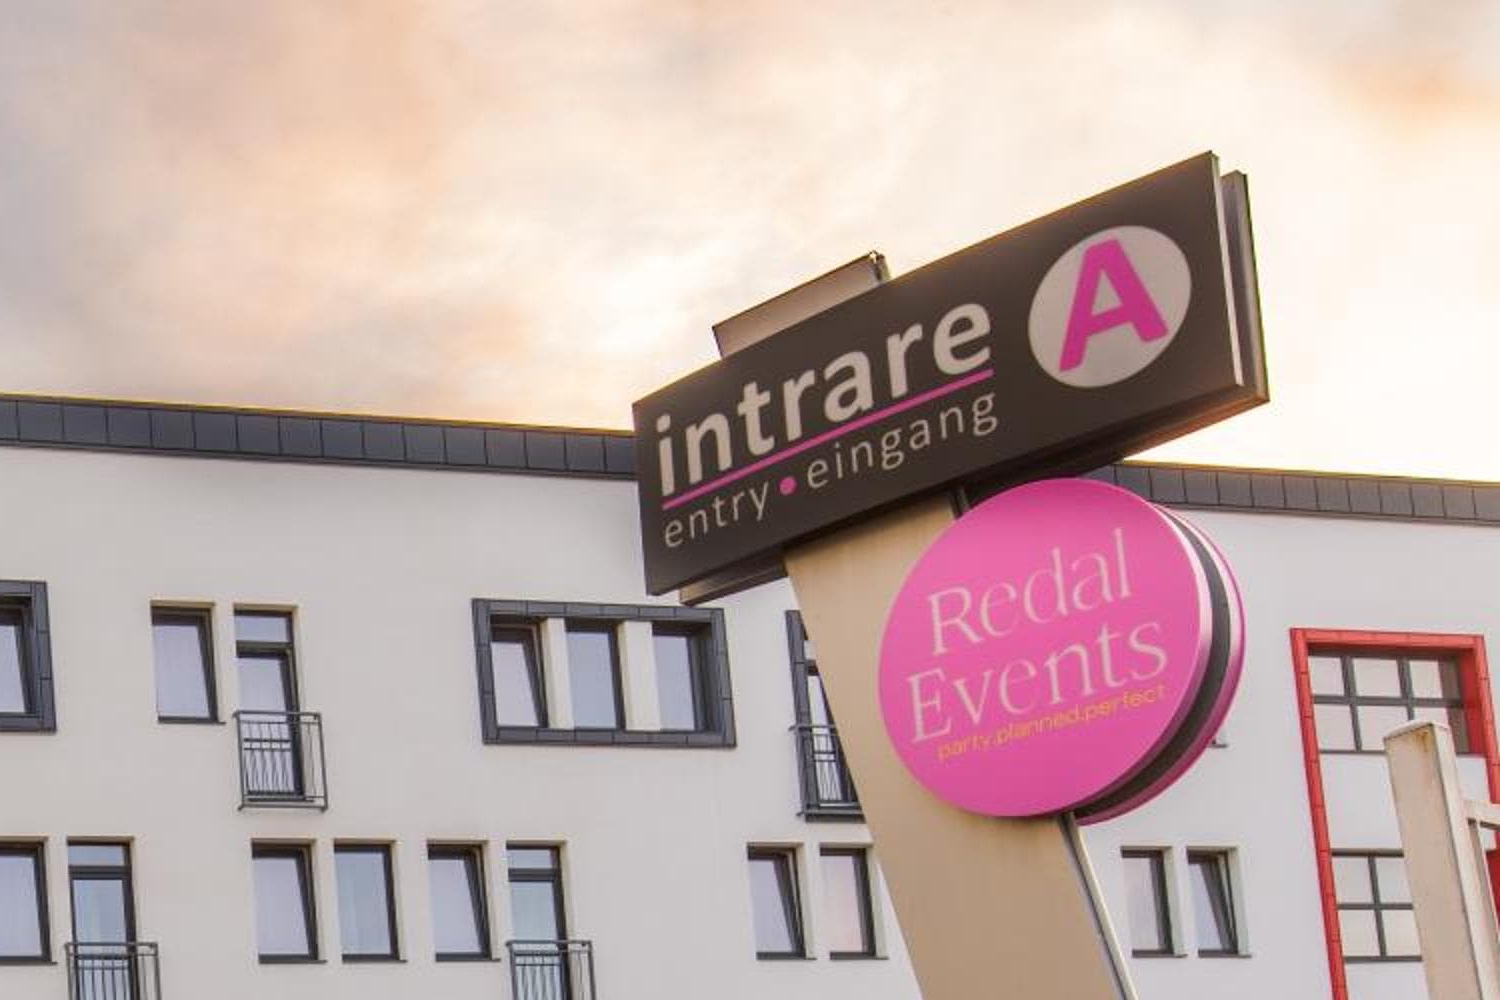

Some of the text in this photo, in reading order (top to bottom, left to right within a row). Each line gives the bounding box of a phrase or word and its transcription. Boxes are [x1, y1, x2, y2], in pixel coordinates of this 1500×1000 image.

[1060, 238, 1167, 371] A
[656, 303, 991, 496] intrare
[664, 392, 997, 548] entry eingang
[929, 527, 1133, 656] Redal
[907, 621, 1169, 744] Events
